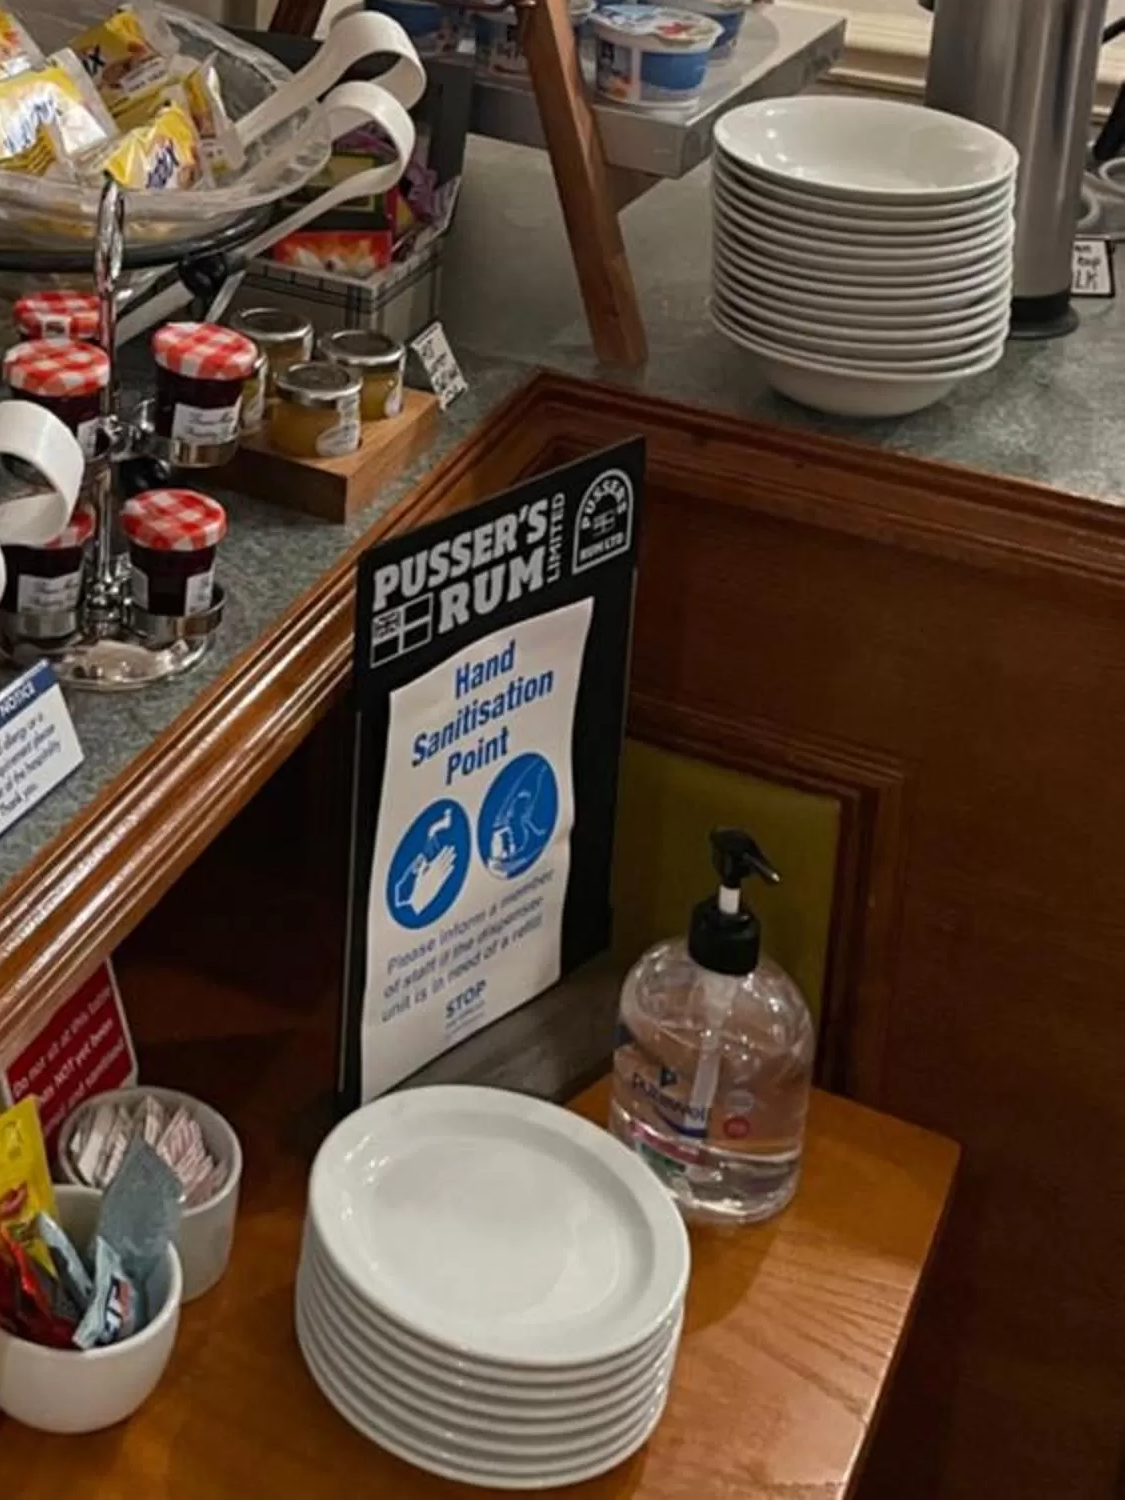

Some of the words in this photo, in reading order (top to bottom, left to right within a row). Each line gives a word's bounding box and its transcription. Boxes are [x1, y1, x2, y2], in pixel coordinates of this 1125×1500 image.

[373, 498, 549, 613] PUSSER'S
[547, 492, 566, 584] LIMITED
[438, 544, 547, 635] RUM
[455, 638, 516, 699] Hand
[411, 669, 554, 768] Sanitisation
[445, 729, 510, 786] Point
[446, 979, 487, 1019] STOP
